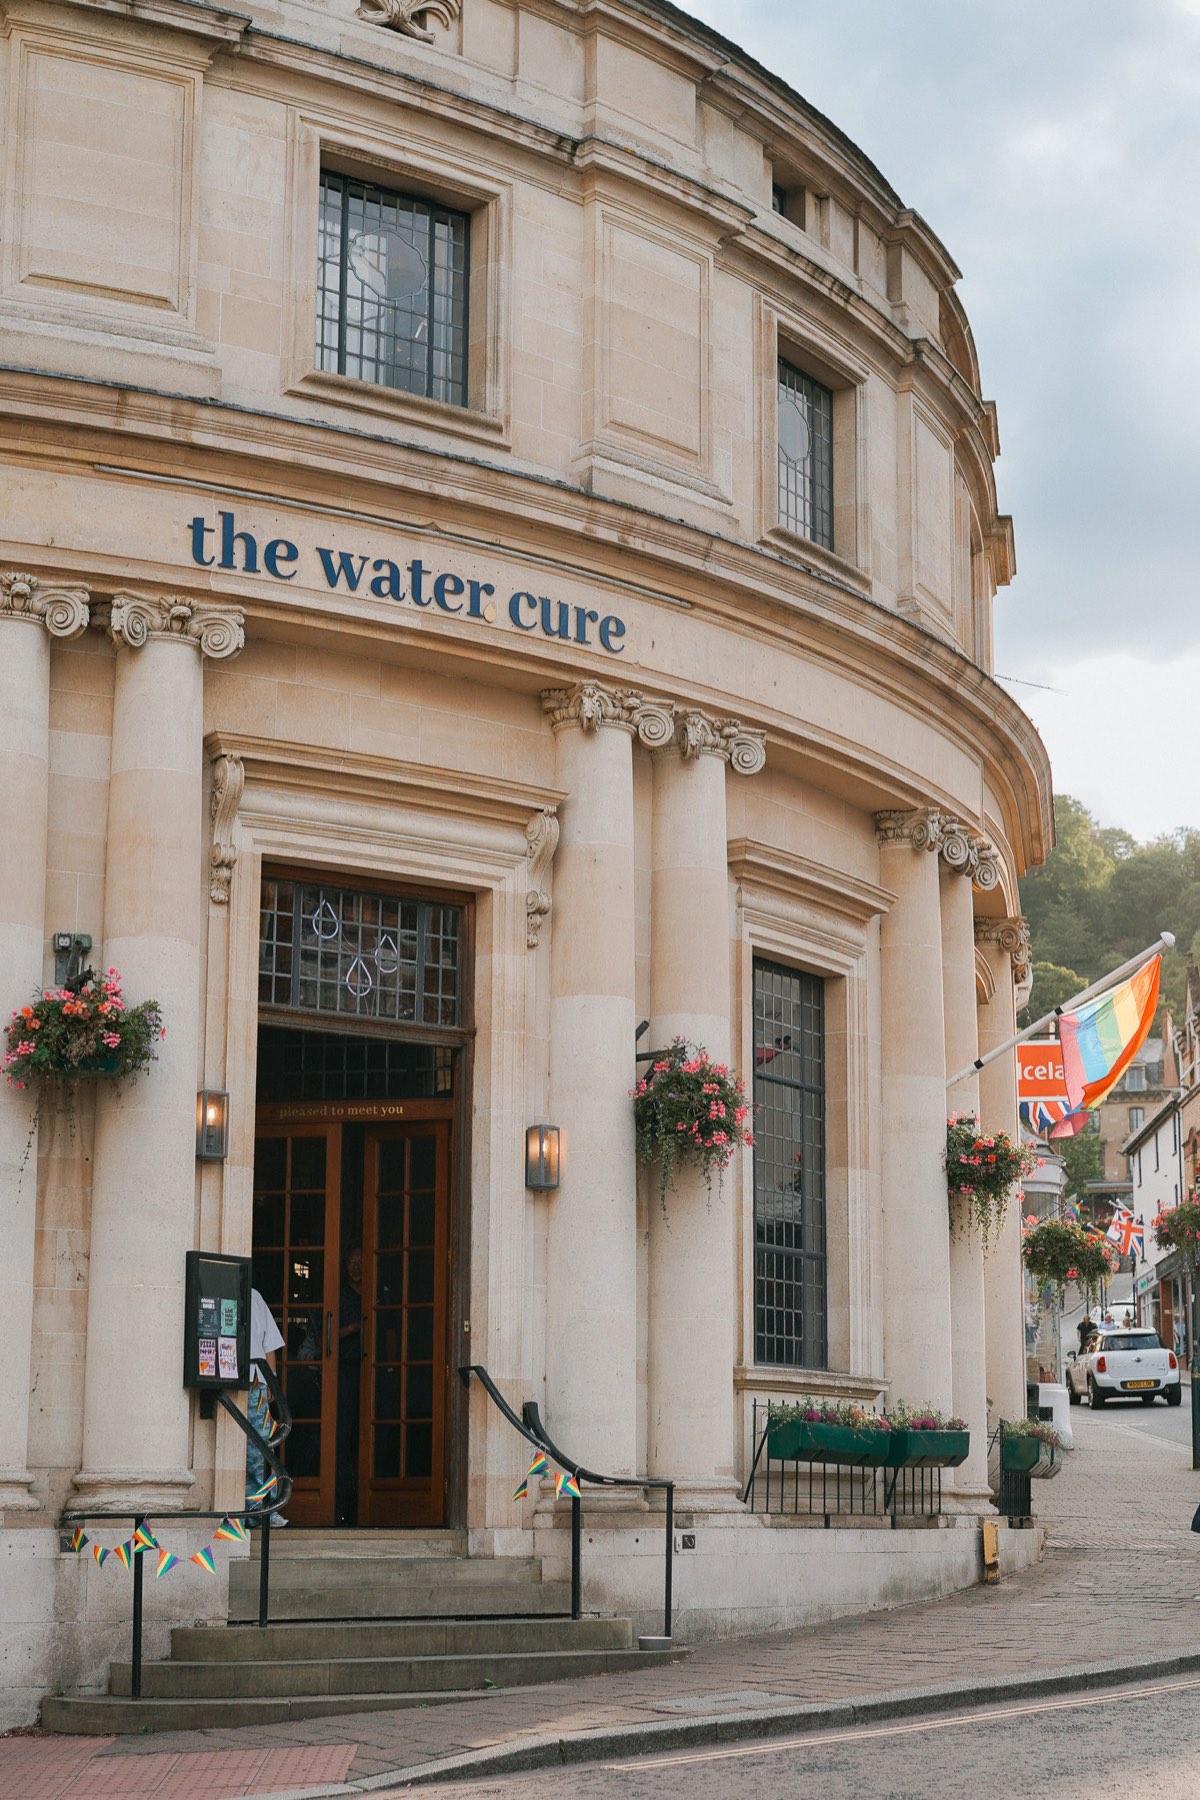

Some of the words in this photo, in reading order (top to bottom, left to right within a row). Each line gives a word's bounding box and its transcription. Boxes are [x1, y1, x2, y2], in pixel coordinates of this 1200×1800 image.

[187, 510, 299, 580] the
[315, 546, 495, 618] water
[508, 590, 627, 654] cure
[279, 1105, 327, 1119] pleased
[331, 1106, 344, 1116] to
[347, 1105, 378, 1116] meet
[381, 1105, 404, 1118] you
